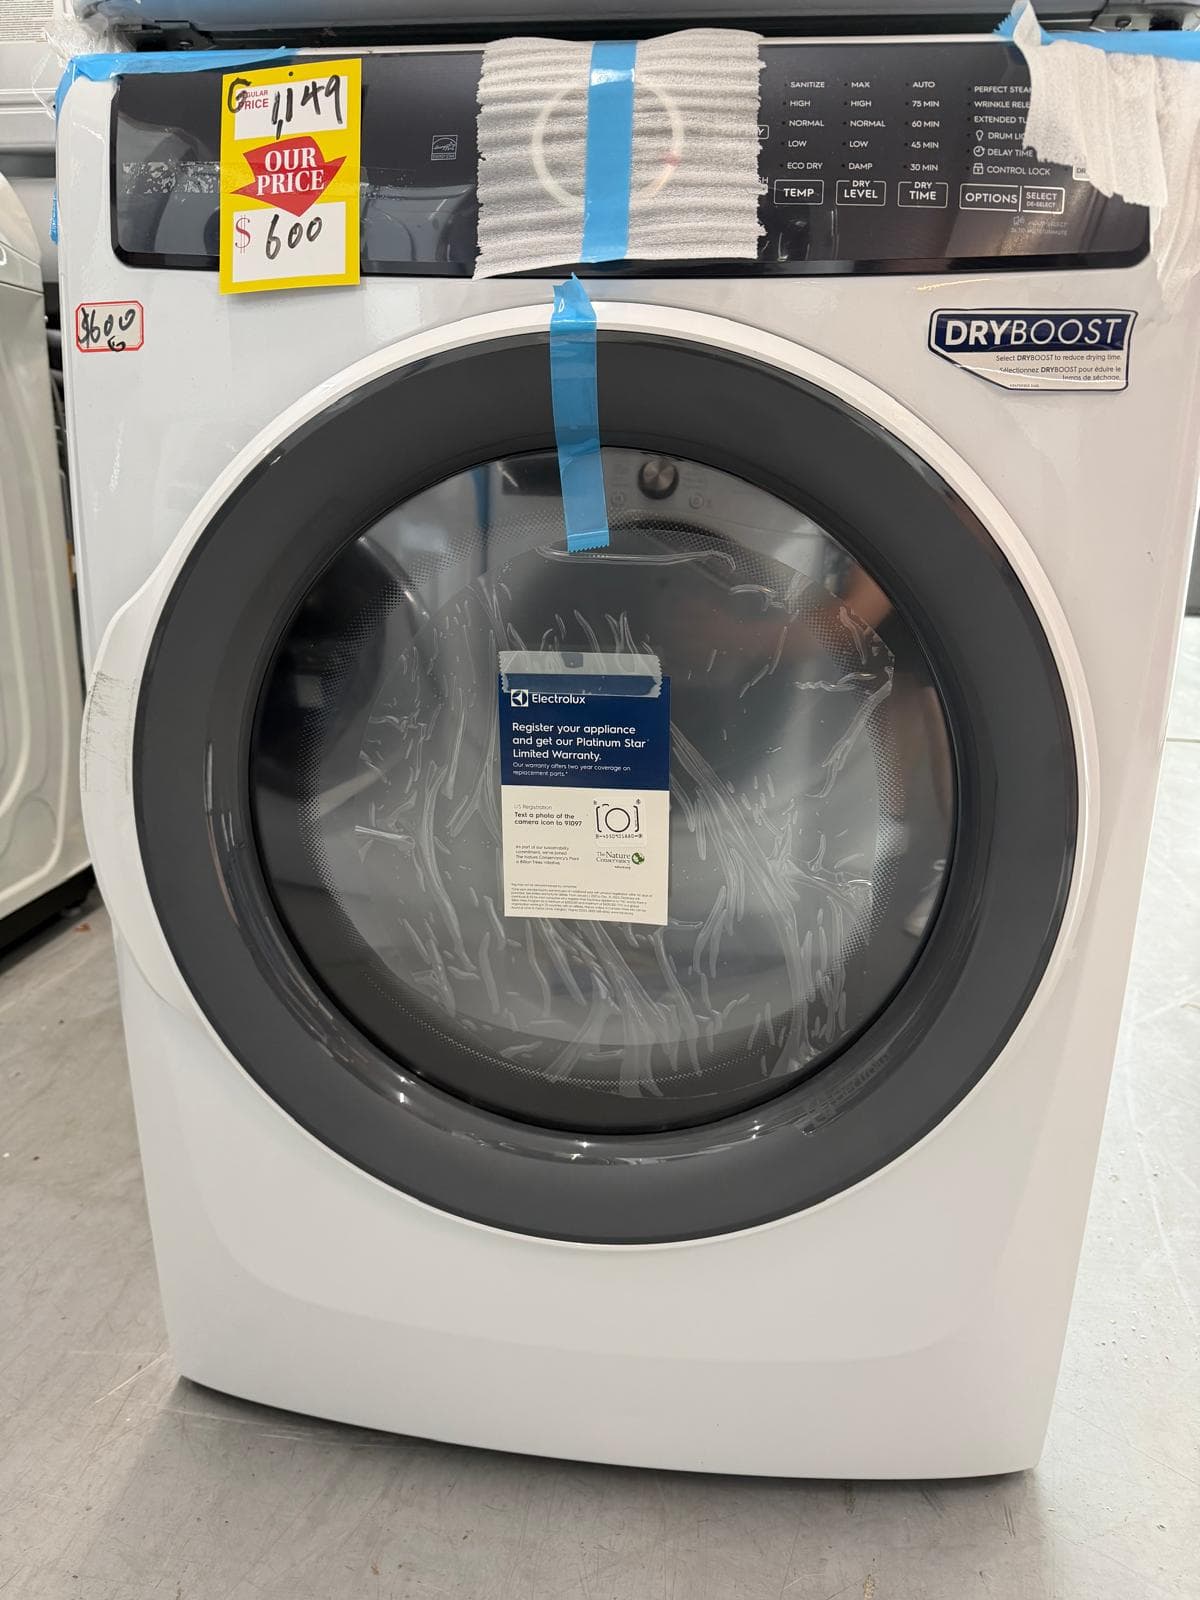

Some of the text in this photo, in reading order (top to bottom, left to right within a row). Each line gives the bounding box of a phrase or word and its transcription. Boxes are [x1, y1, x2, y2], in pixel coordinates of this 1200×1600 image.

[1012, 101, 1031, 109] RELE
[911, 120, 922, 128] 60
[974, 116, 1017, 124] EXTENDED
[988, 132, 1013, 140] DRUM
[849, 140, 869, 148] LOW
[987, 149, 1012, 157] DELAY
[264, 147, 317, 172] OUR
[787, 162, 823, 170] ECO DRY
[848, 162, 873, 170] DAMP
[986, 166, 1051, 175] CONTROL LOCK
[255, 169, 325, 196] PRICE
[852, 180, 871, 188] DRY
[914, 181, 932, 189] DRY
[783, 188, 815, 197] TEMP
[844, 189, 878, 199] LEVEL
[909, 190, 937, 200] TIME
[1025, 191, 1057, 201] SELECT
[965, 192, 1018, 204] OPTIONS
[235, 214, 322, 260] $ 600
[78, 307, 136, 348] $600
[945, 318, 1122, 346] DRYBOOST
[996, 354, 1015, 362] Select
[1085, 354, 1105, 362] drying
[531, 693, 586, 704] Electrolux
[512, 722, 636, 735] Register your appliance
[512, 736, 647, 748] and get our Platinum Star
[512, 748, 602, 762] Limited Warranty.
[512, 769, 549, 777] replacement
[605, 850, 631, 860] Nature
